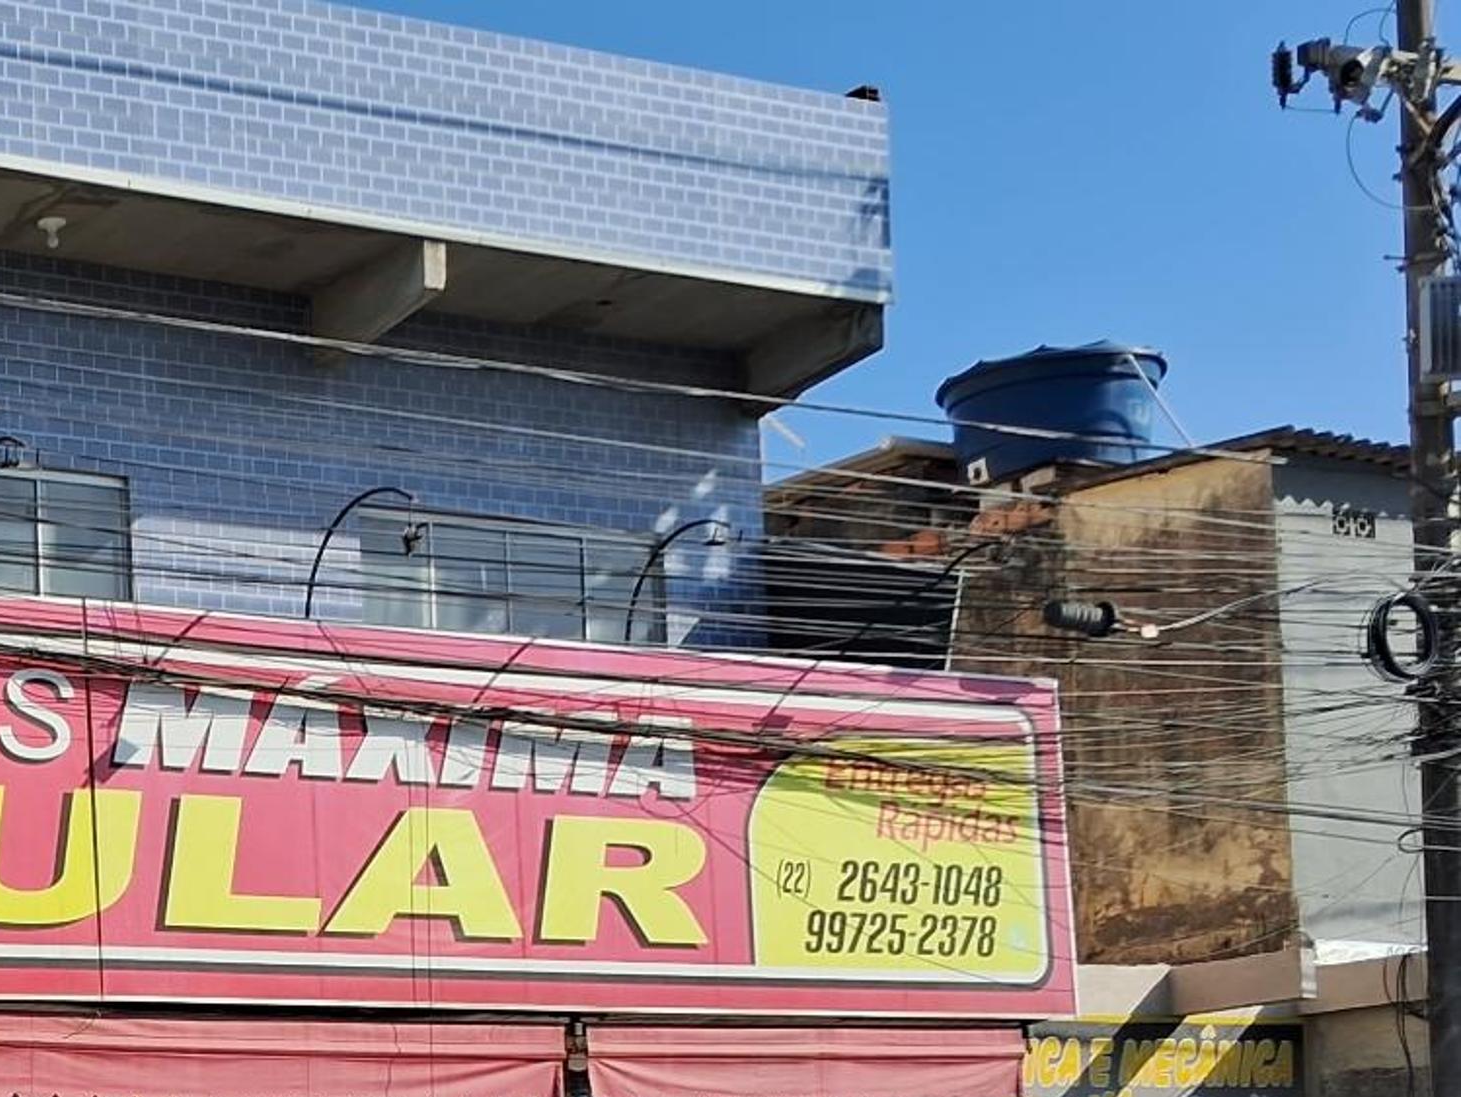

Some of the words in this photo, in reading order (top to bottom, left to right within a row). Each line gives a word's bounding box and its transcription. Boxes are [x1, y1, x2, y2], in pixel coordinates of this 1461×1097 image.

[776, 858, 812, 900] (22)
[837, 859, 1003, 908] 2643-1048
[804, 908, 998, 958] 99725-2378
